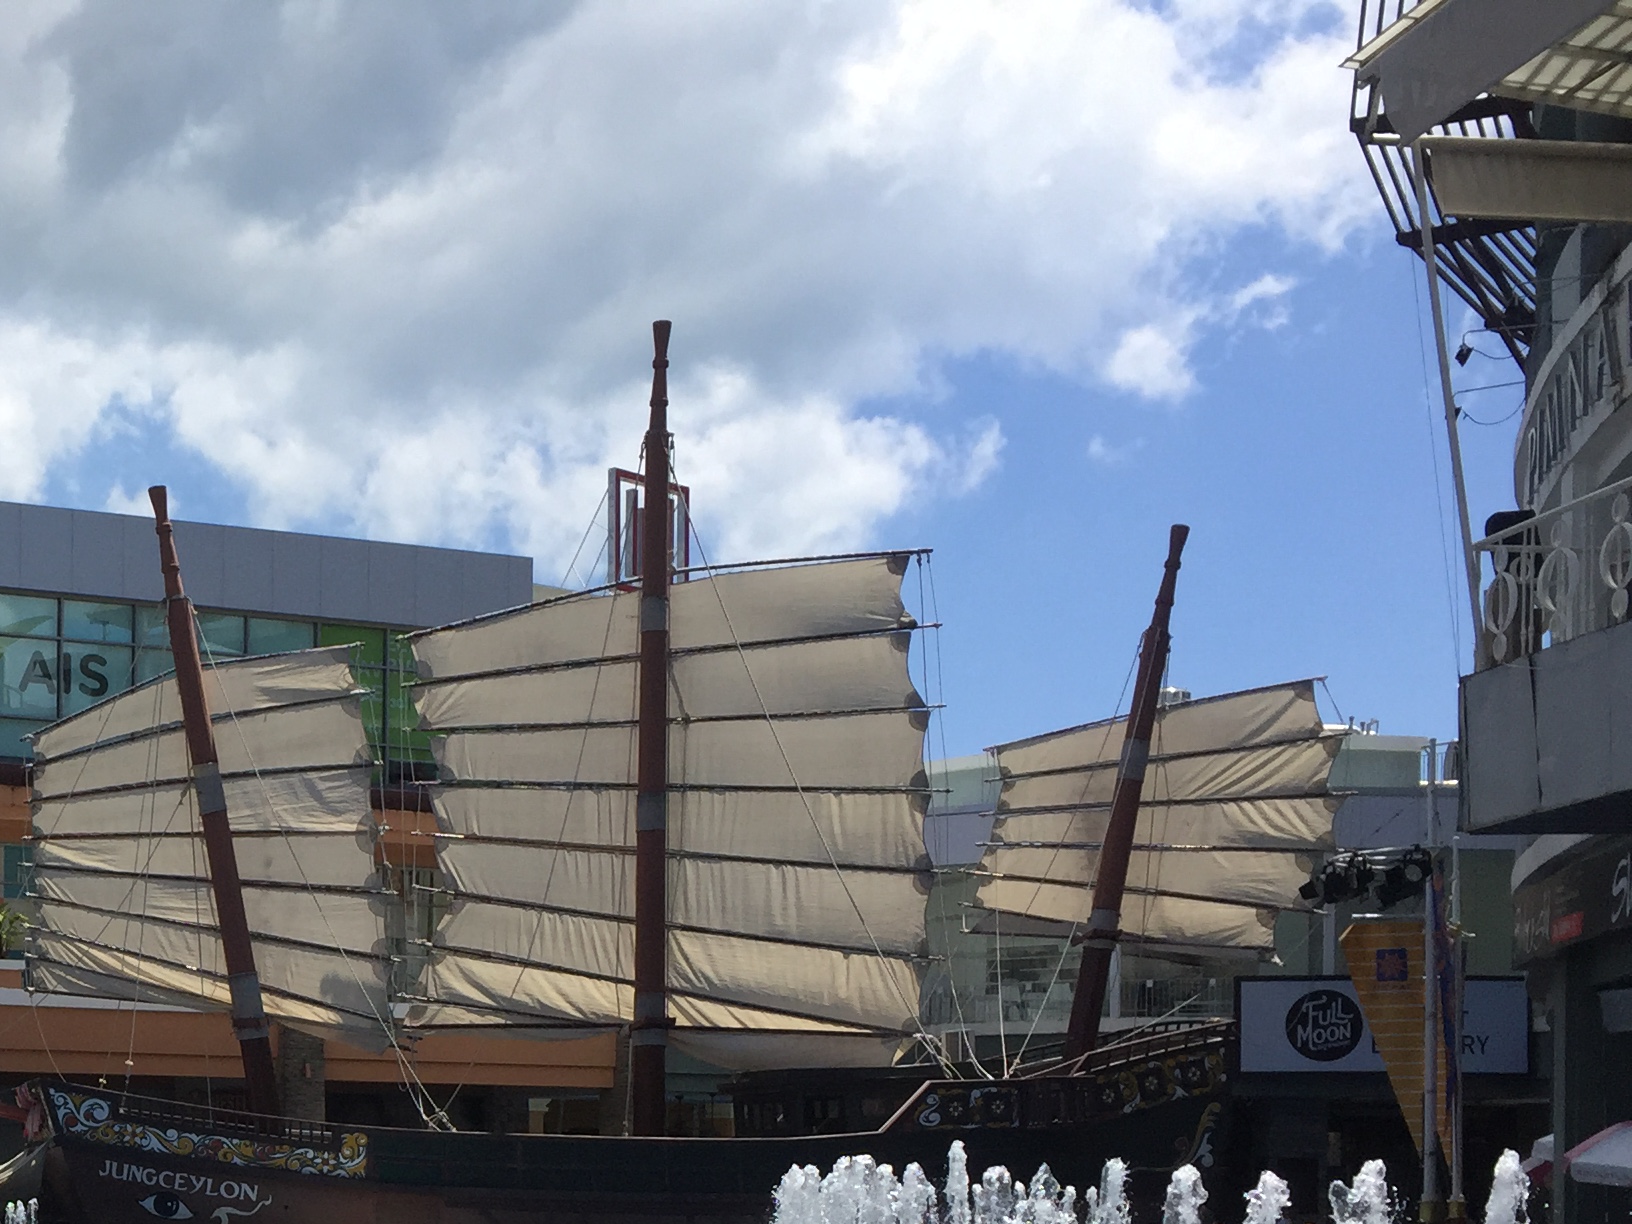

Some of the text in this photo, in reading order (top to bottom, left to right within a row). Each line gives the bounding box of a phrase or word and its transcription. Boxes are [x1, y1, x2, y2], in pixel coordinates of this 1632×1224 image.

[18, 650, 109, 697] AIS
[1301, 994, 1354, 1028] FULL
[1296, 1022, 1353, 1051] MOON
[98, 1159, 259, 1202] JUNGCEYLON
